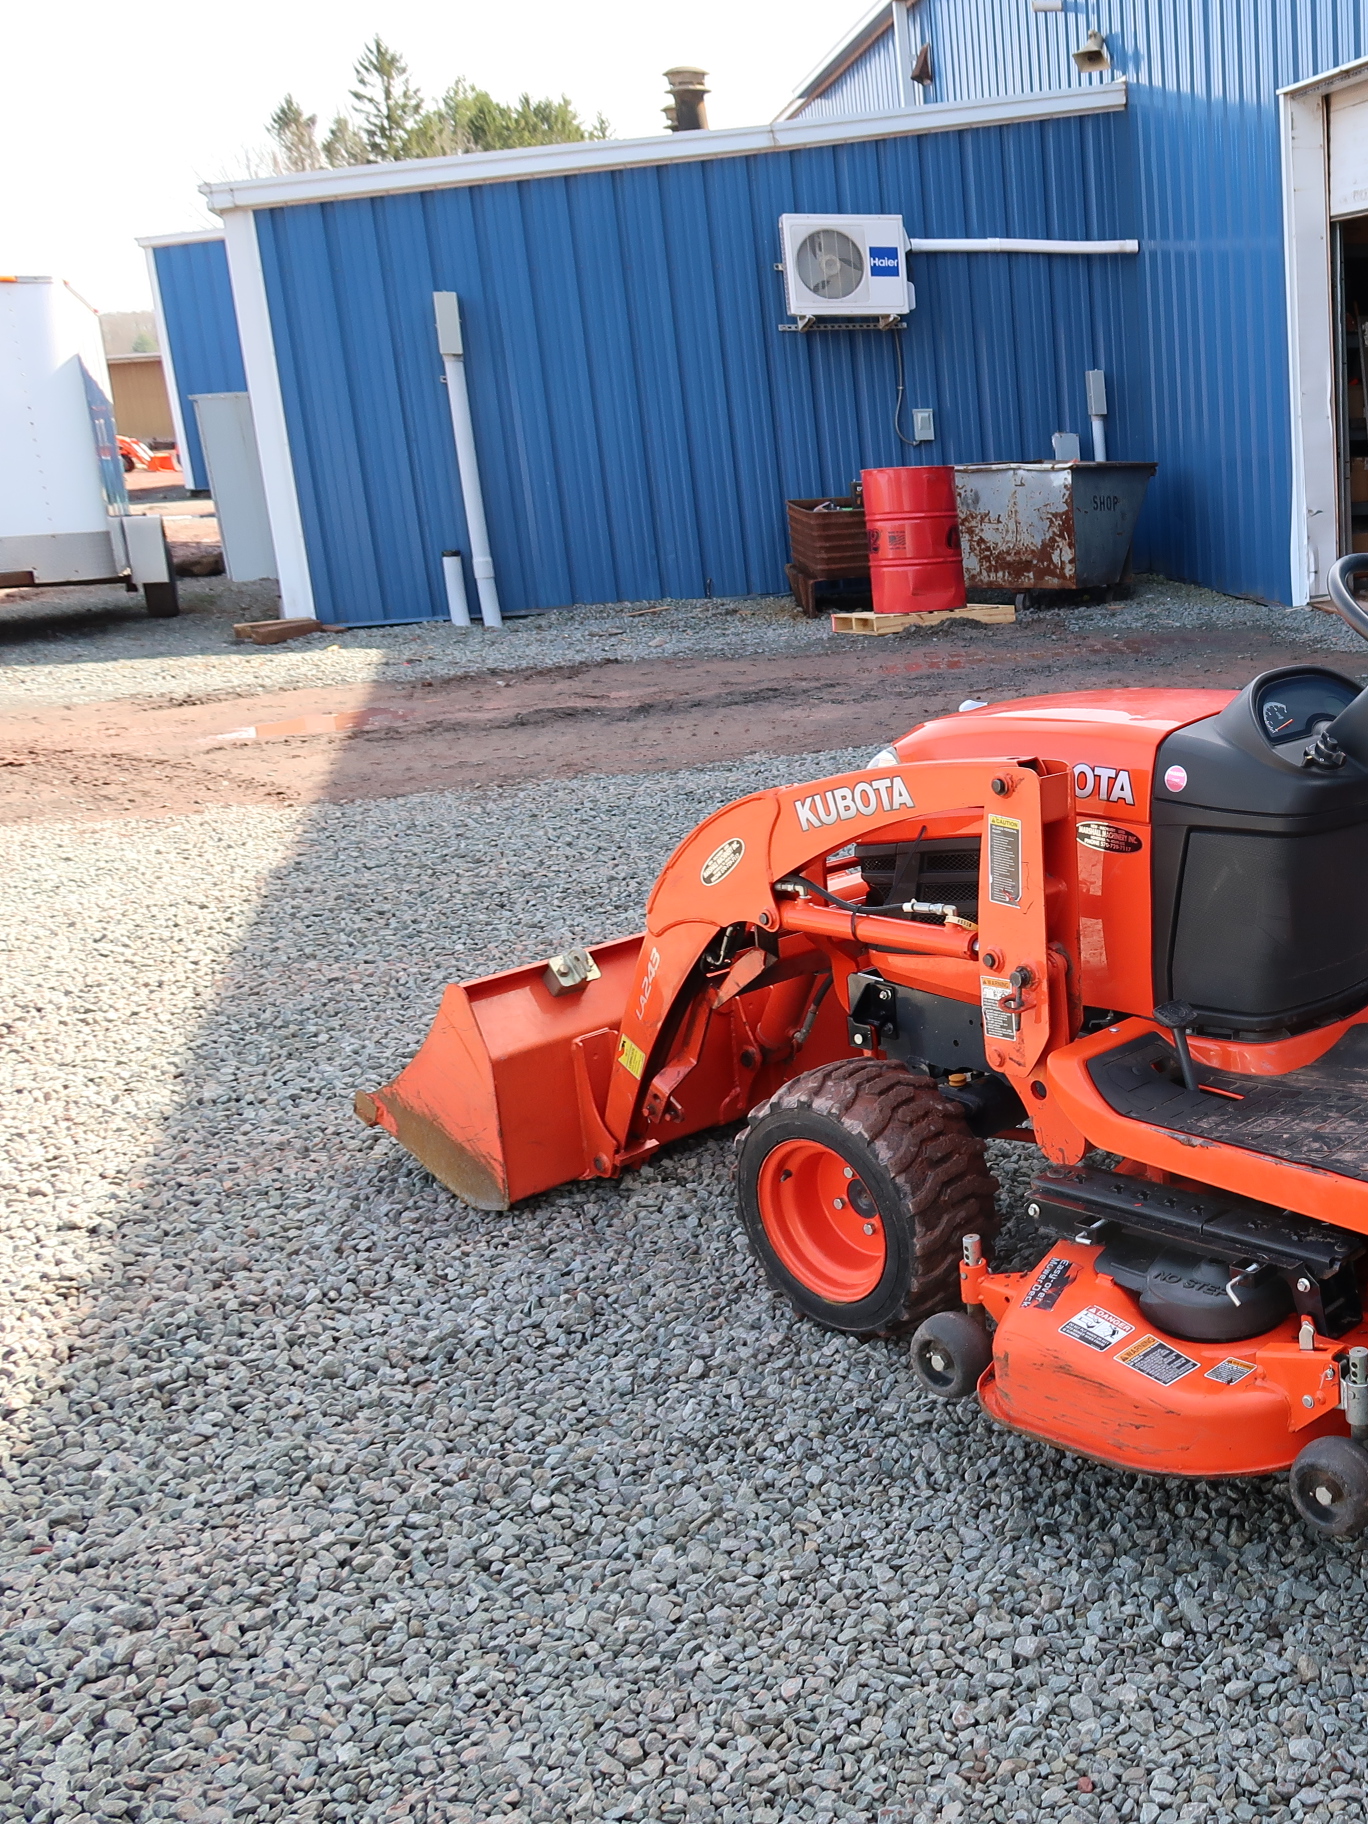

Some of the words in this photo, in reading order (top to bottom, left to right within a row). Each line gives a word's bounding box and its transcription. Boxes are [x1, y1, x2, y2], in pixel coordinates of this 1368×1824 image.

[870, 257, 898, 267] Haier
[1093, 495, 1118, 511] SHOP
[1073, 763, 1135, 806] OTA
[794, 775, 915, 831] KUBOTA
[996, 817, 1019, 828] CAUTION
[635, 946, 660, 1021] LA243
[1035, 1259, 1069, 1302] Easy-over
[1036, 1257, 1060, 1284] Mower
[1153, 1270, 1181, 1284] NO
[1183, 1279, 1228, 1297] STEP
[1020, 1283, 1042, 1308] Deck
[1096, 1309, 1132, 1332] DANGER
[1124, 1337, 1156, 1358] WARNING
